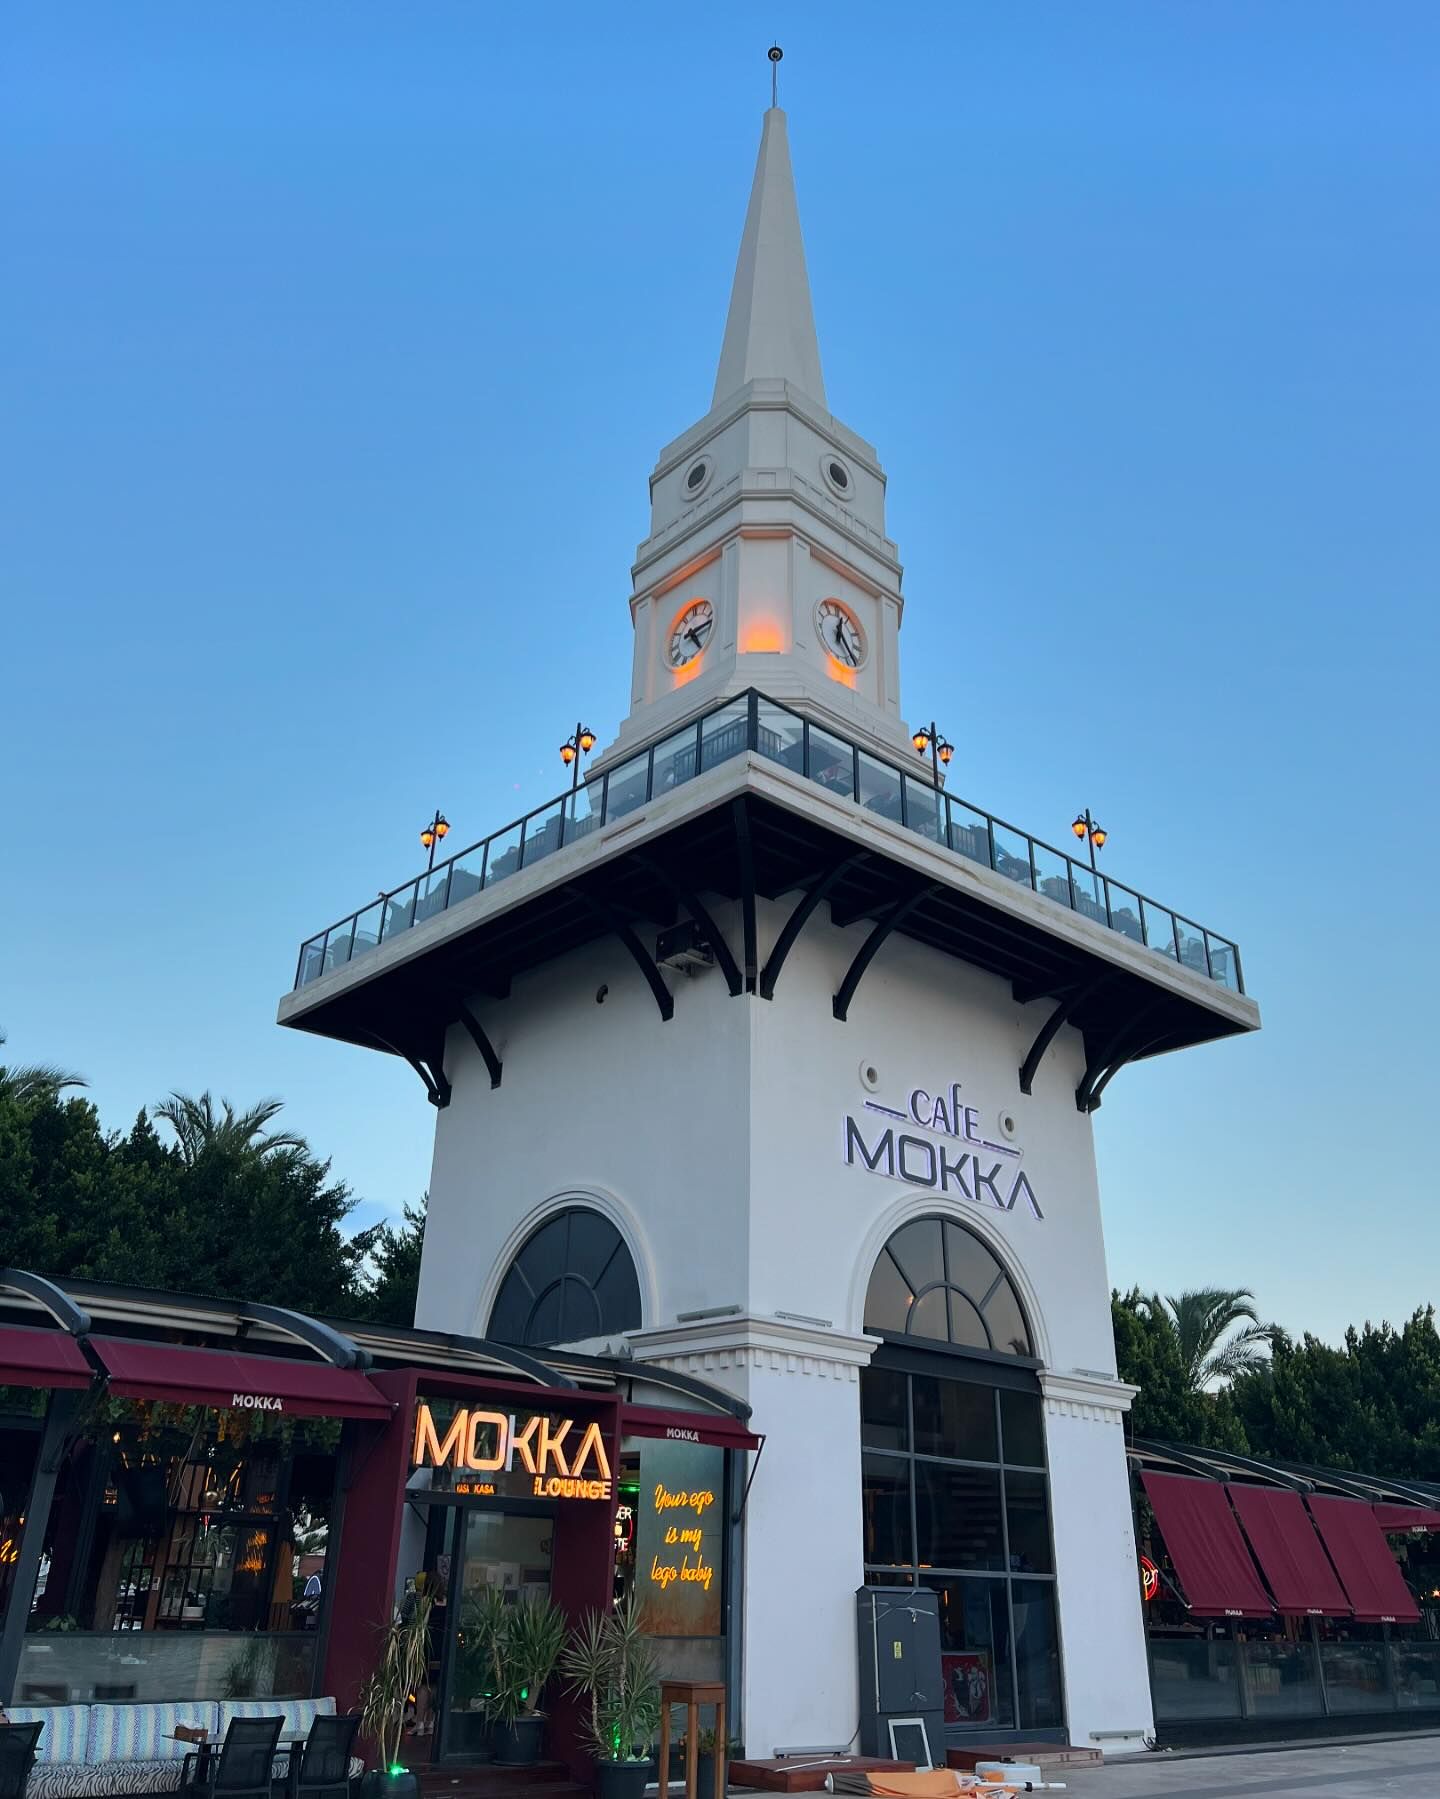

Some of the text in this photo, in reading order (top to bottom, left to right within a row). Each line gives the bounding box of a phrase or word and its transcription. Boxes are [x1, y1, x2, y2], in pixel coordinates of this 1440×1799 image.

[845, 1116, 1044, 1219] MOKKA
[232, 1393, 283, 1411] MOKKA
[413, 1404, 612, 1480] MOKKA
[666, 1427, 700, 1442] MOKKA
[535, 1476, 612, 1500] LOUNGE
[655, 1483, 714, 1515] Your ego
[665, 1526, 702, 1552] is my
[651, 1554, 713, 1591] lego baby
